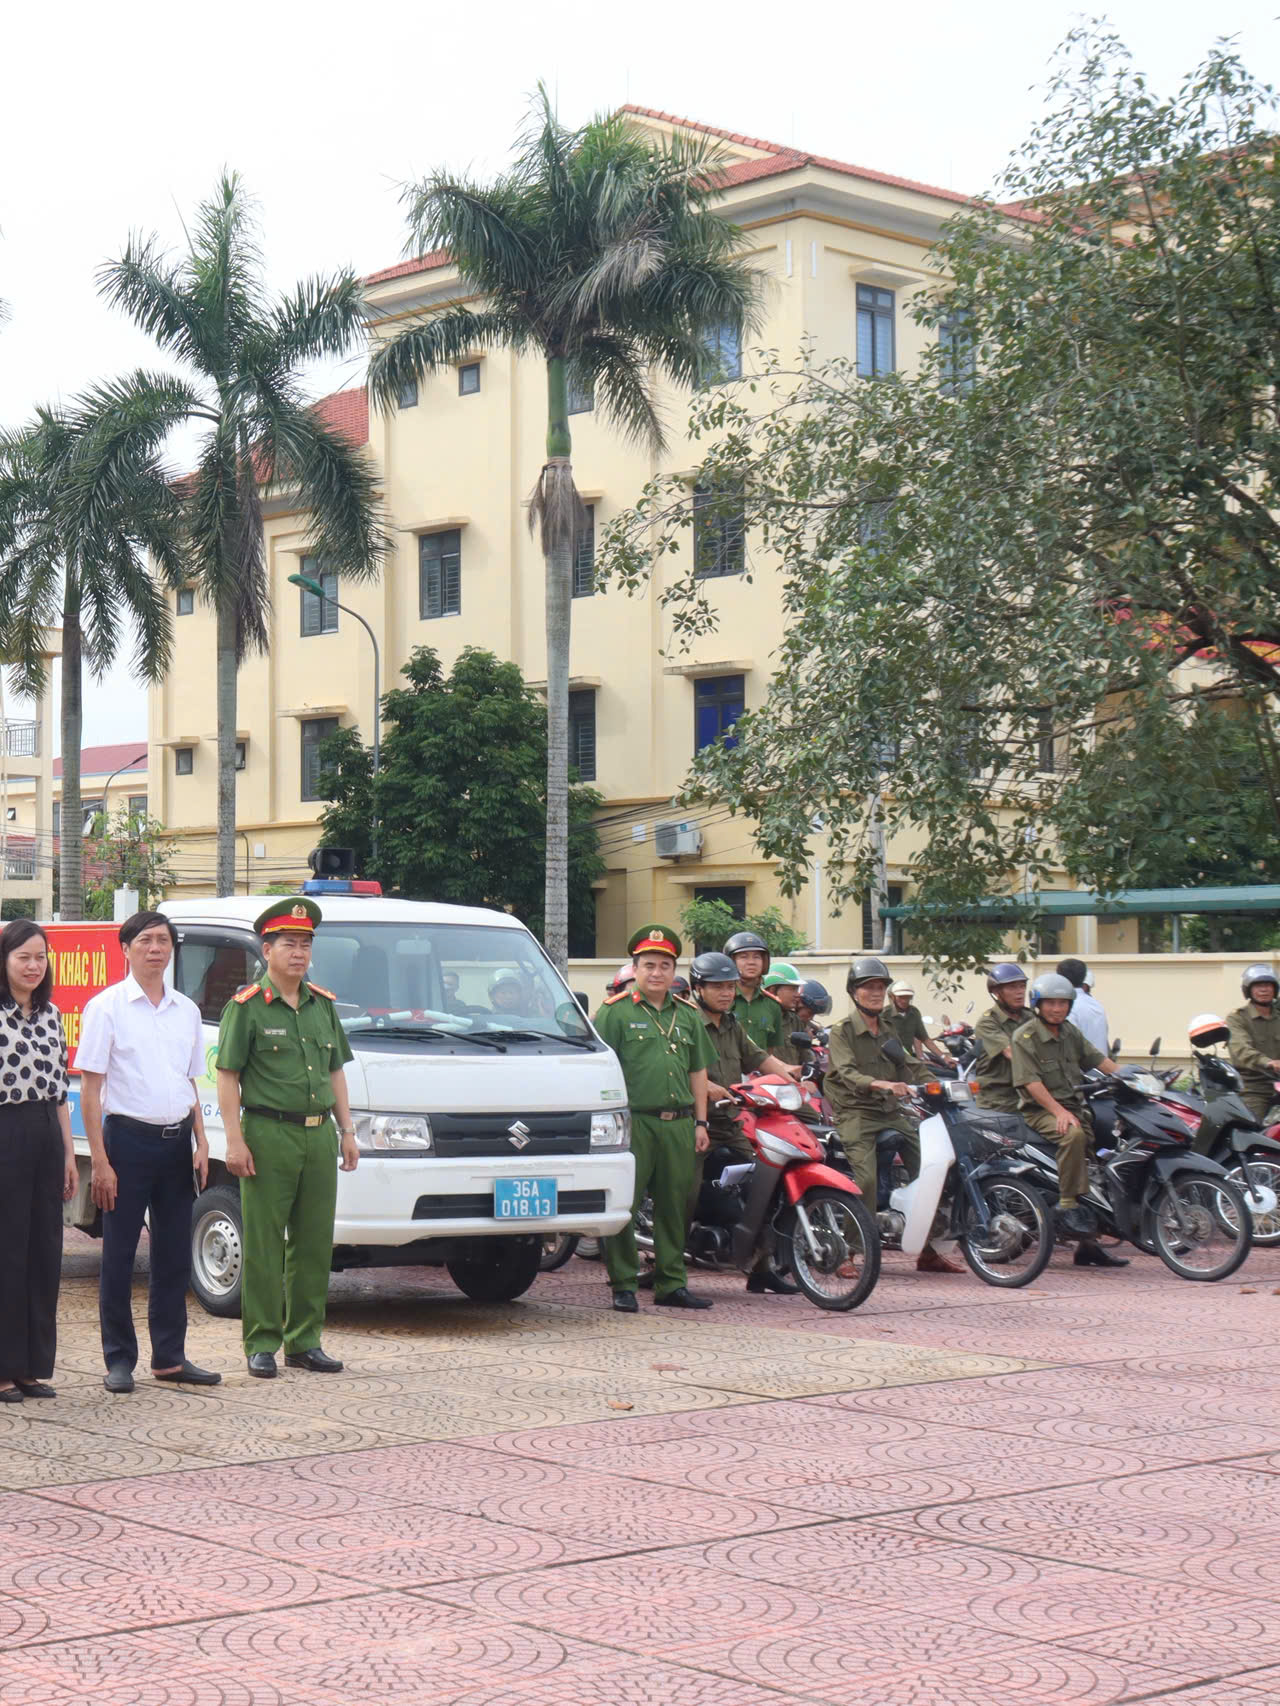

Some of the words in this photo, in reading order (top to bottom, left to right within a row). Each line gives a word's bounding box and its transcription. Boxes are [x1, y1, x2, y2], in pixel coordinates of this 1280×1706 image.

[60, 944, 89, 986] KHÁC
[92, 944, 107, 986] VÀ
[512, 1181, 539, 1197] 36A
[502, 1199, 550, 1216] 018.13
